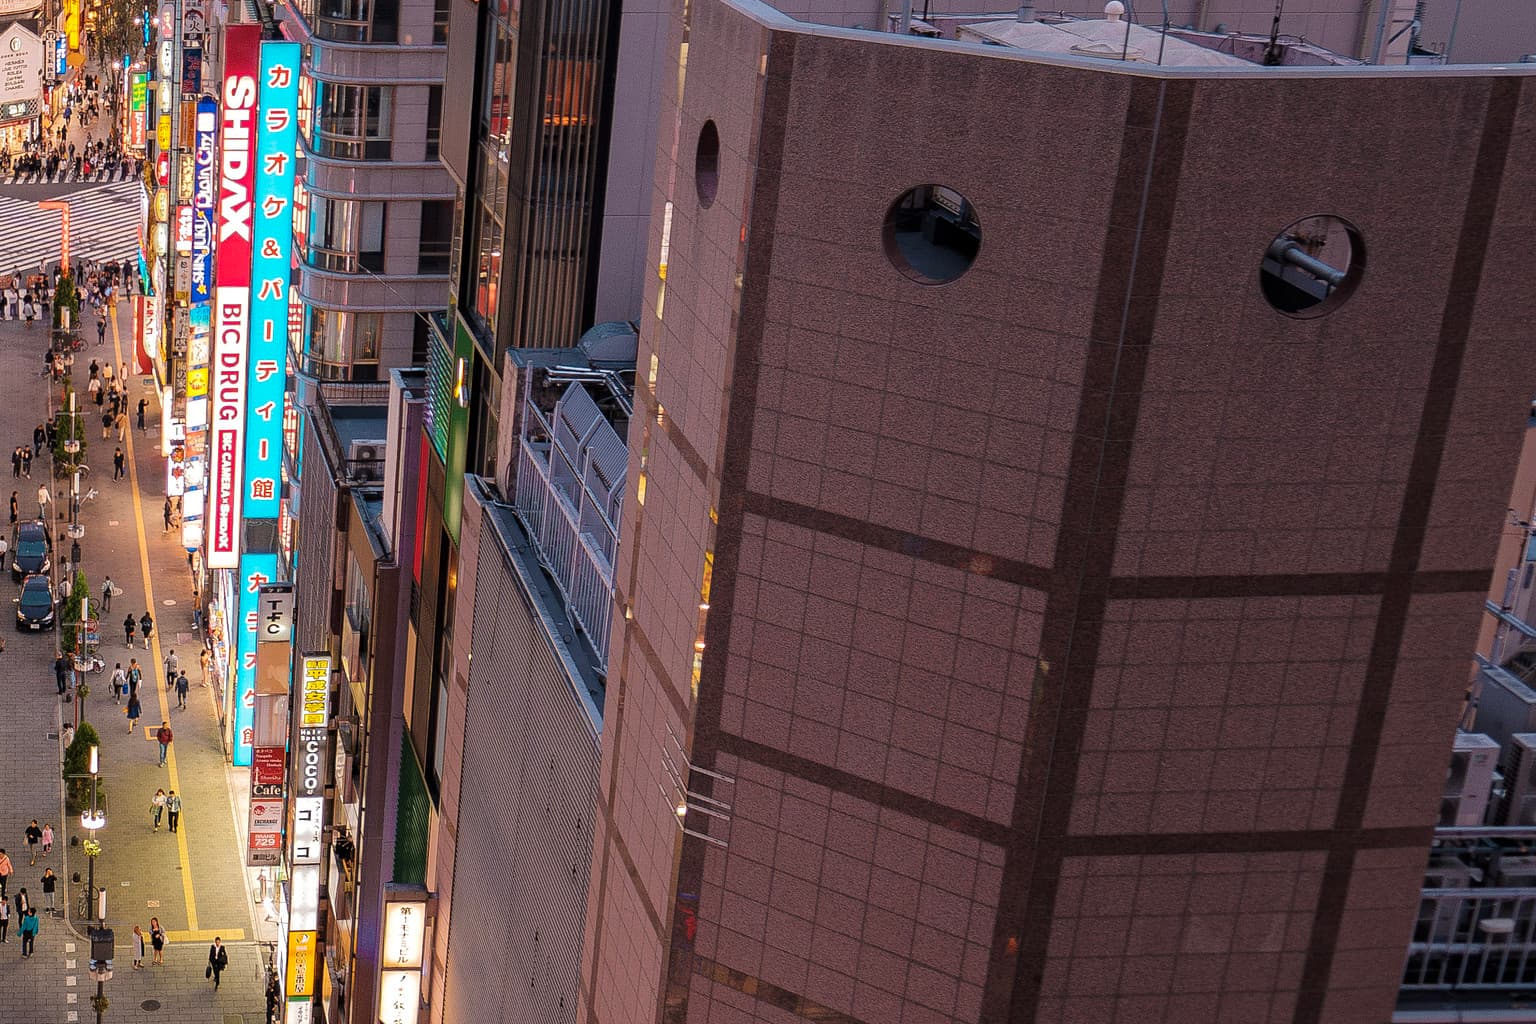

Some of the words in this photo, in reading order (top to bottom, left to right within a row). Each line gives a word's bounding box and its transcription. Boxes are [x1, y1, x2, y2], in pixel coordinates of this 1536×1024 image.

[221, 74, 255, 242] SHIDAX
[193, 219, 210, 285] SHINJUKU
[251, 65, 291, 499] カラオケ&パーティー館
[221, 303, 242, 345] BIC
[219, 352, 239, 421] DRUG
[221, 432, 233, 454] BIC
[303, 669, 327, 725] 平成女学園
[305, 741, 319, 789] COCO
[253, 784, 282, 795] Cafe
[254, 838, 276, 846] 729
[297, 810, 312, 858] ココ
